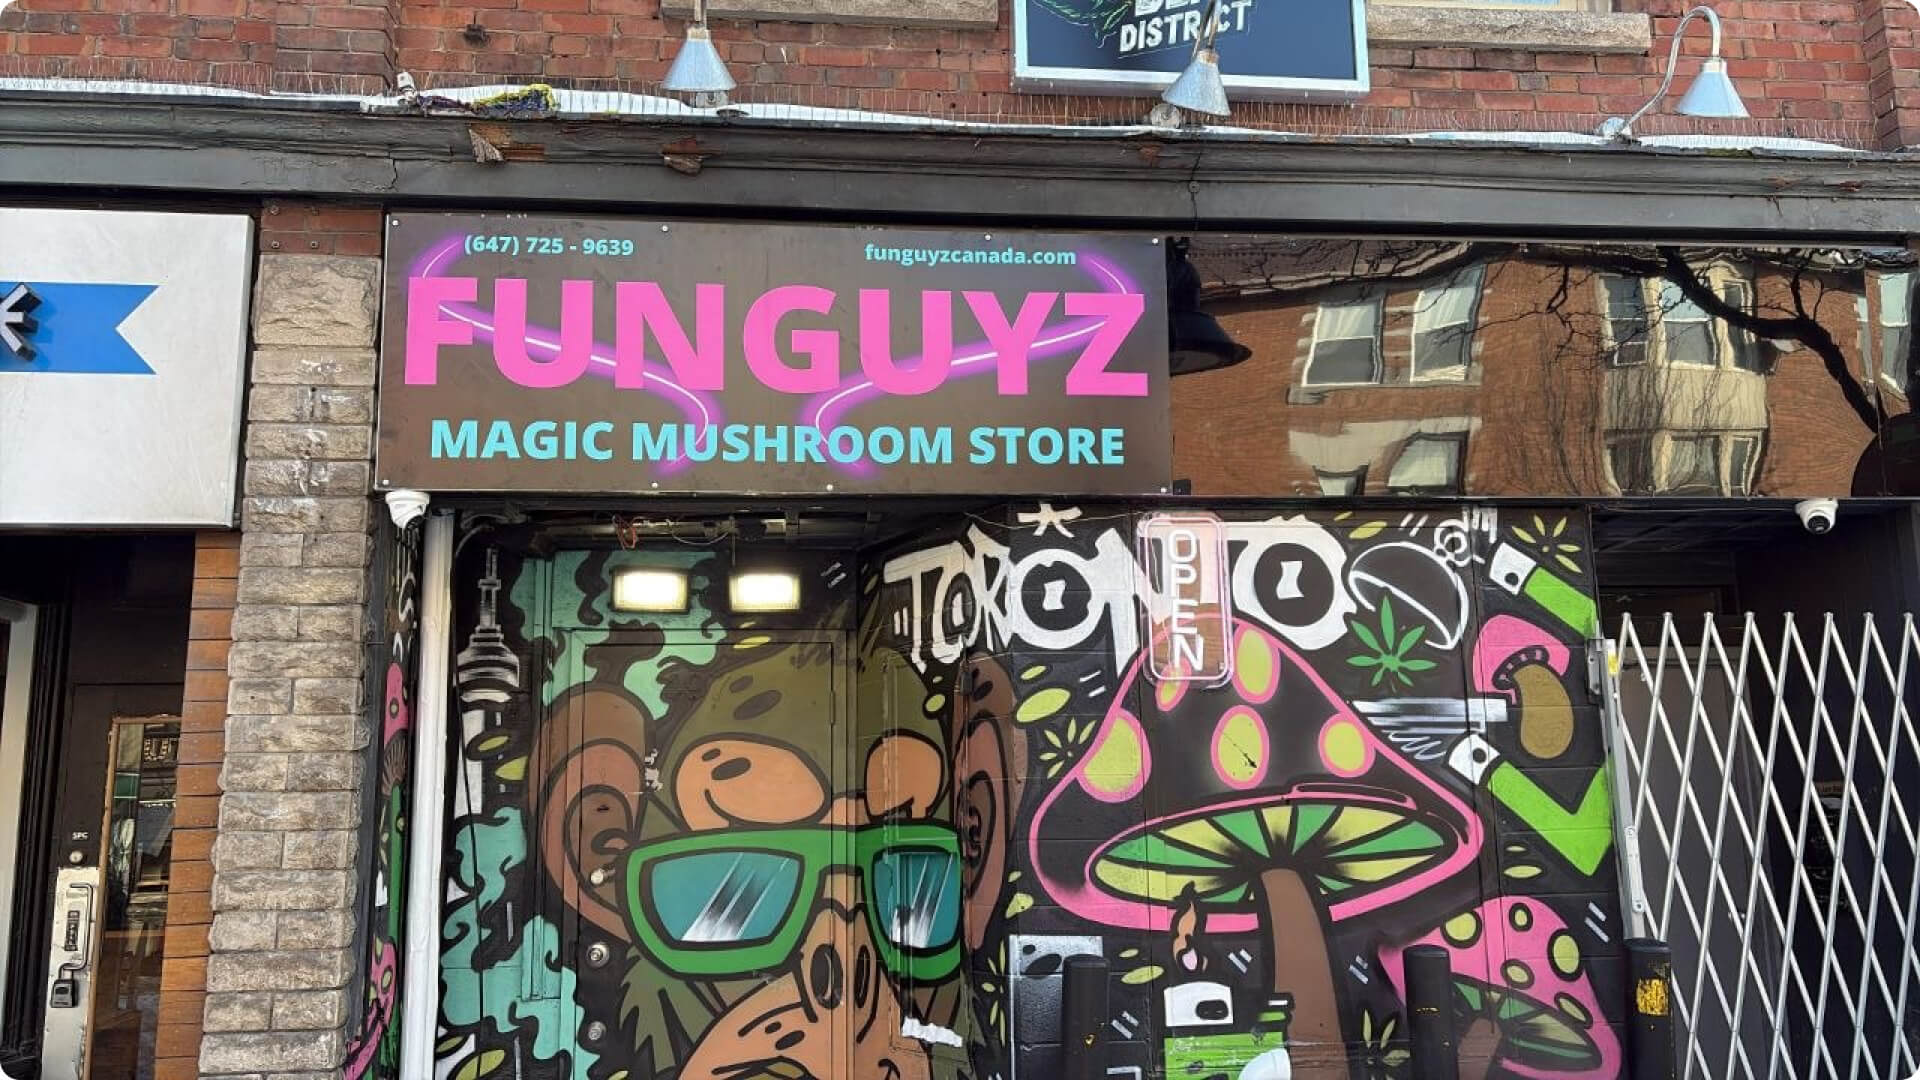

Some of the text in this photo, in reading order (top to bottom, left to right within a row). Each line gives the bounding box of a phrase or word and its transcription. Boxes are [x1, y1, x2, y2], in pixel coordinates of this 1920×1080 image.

[465, 235, 520, 256] (647)
[526, 238, 564, 254] 725
[583, 240, 634, 256] 9639
[864, 244, 1077, 266] funguyzcanada.com
[404, 277, 1149, 397] FUNGUYZ
[431, 420, 1125, 465] MAGIC MUSHROOM STORE
[884, 514, 1357, 678] TORONTO
[1169, 529, 1204, 671] OPEN
